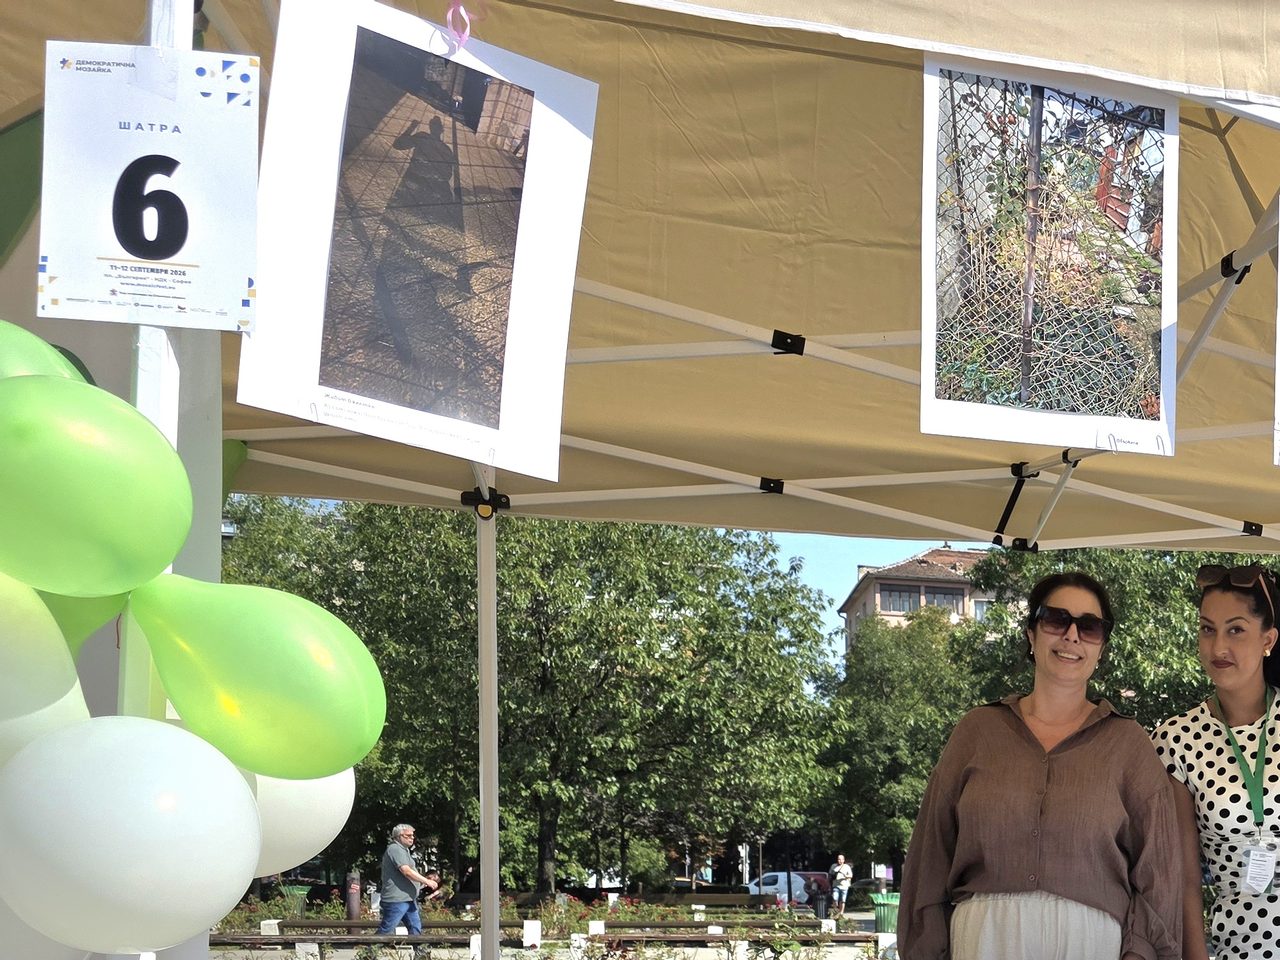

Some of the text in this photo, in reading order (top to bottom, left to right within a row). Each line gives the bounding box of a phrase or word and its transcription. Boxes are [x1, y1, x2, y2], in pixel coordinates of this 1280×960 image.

[75, 59, 136, 68] ДЕМОКРАТИЧНА
[118, 121, 181, 134] ШАТРА
[112, 154, 189, 261] 6
